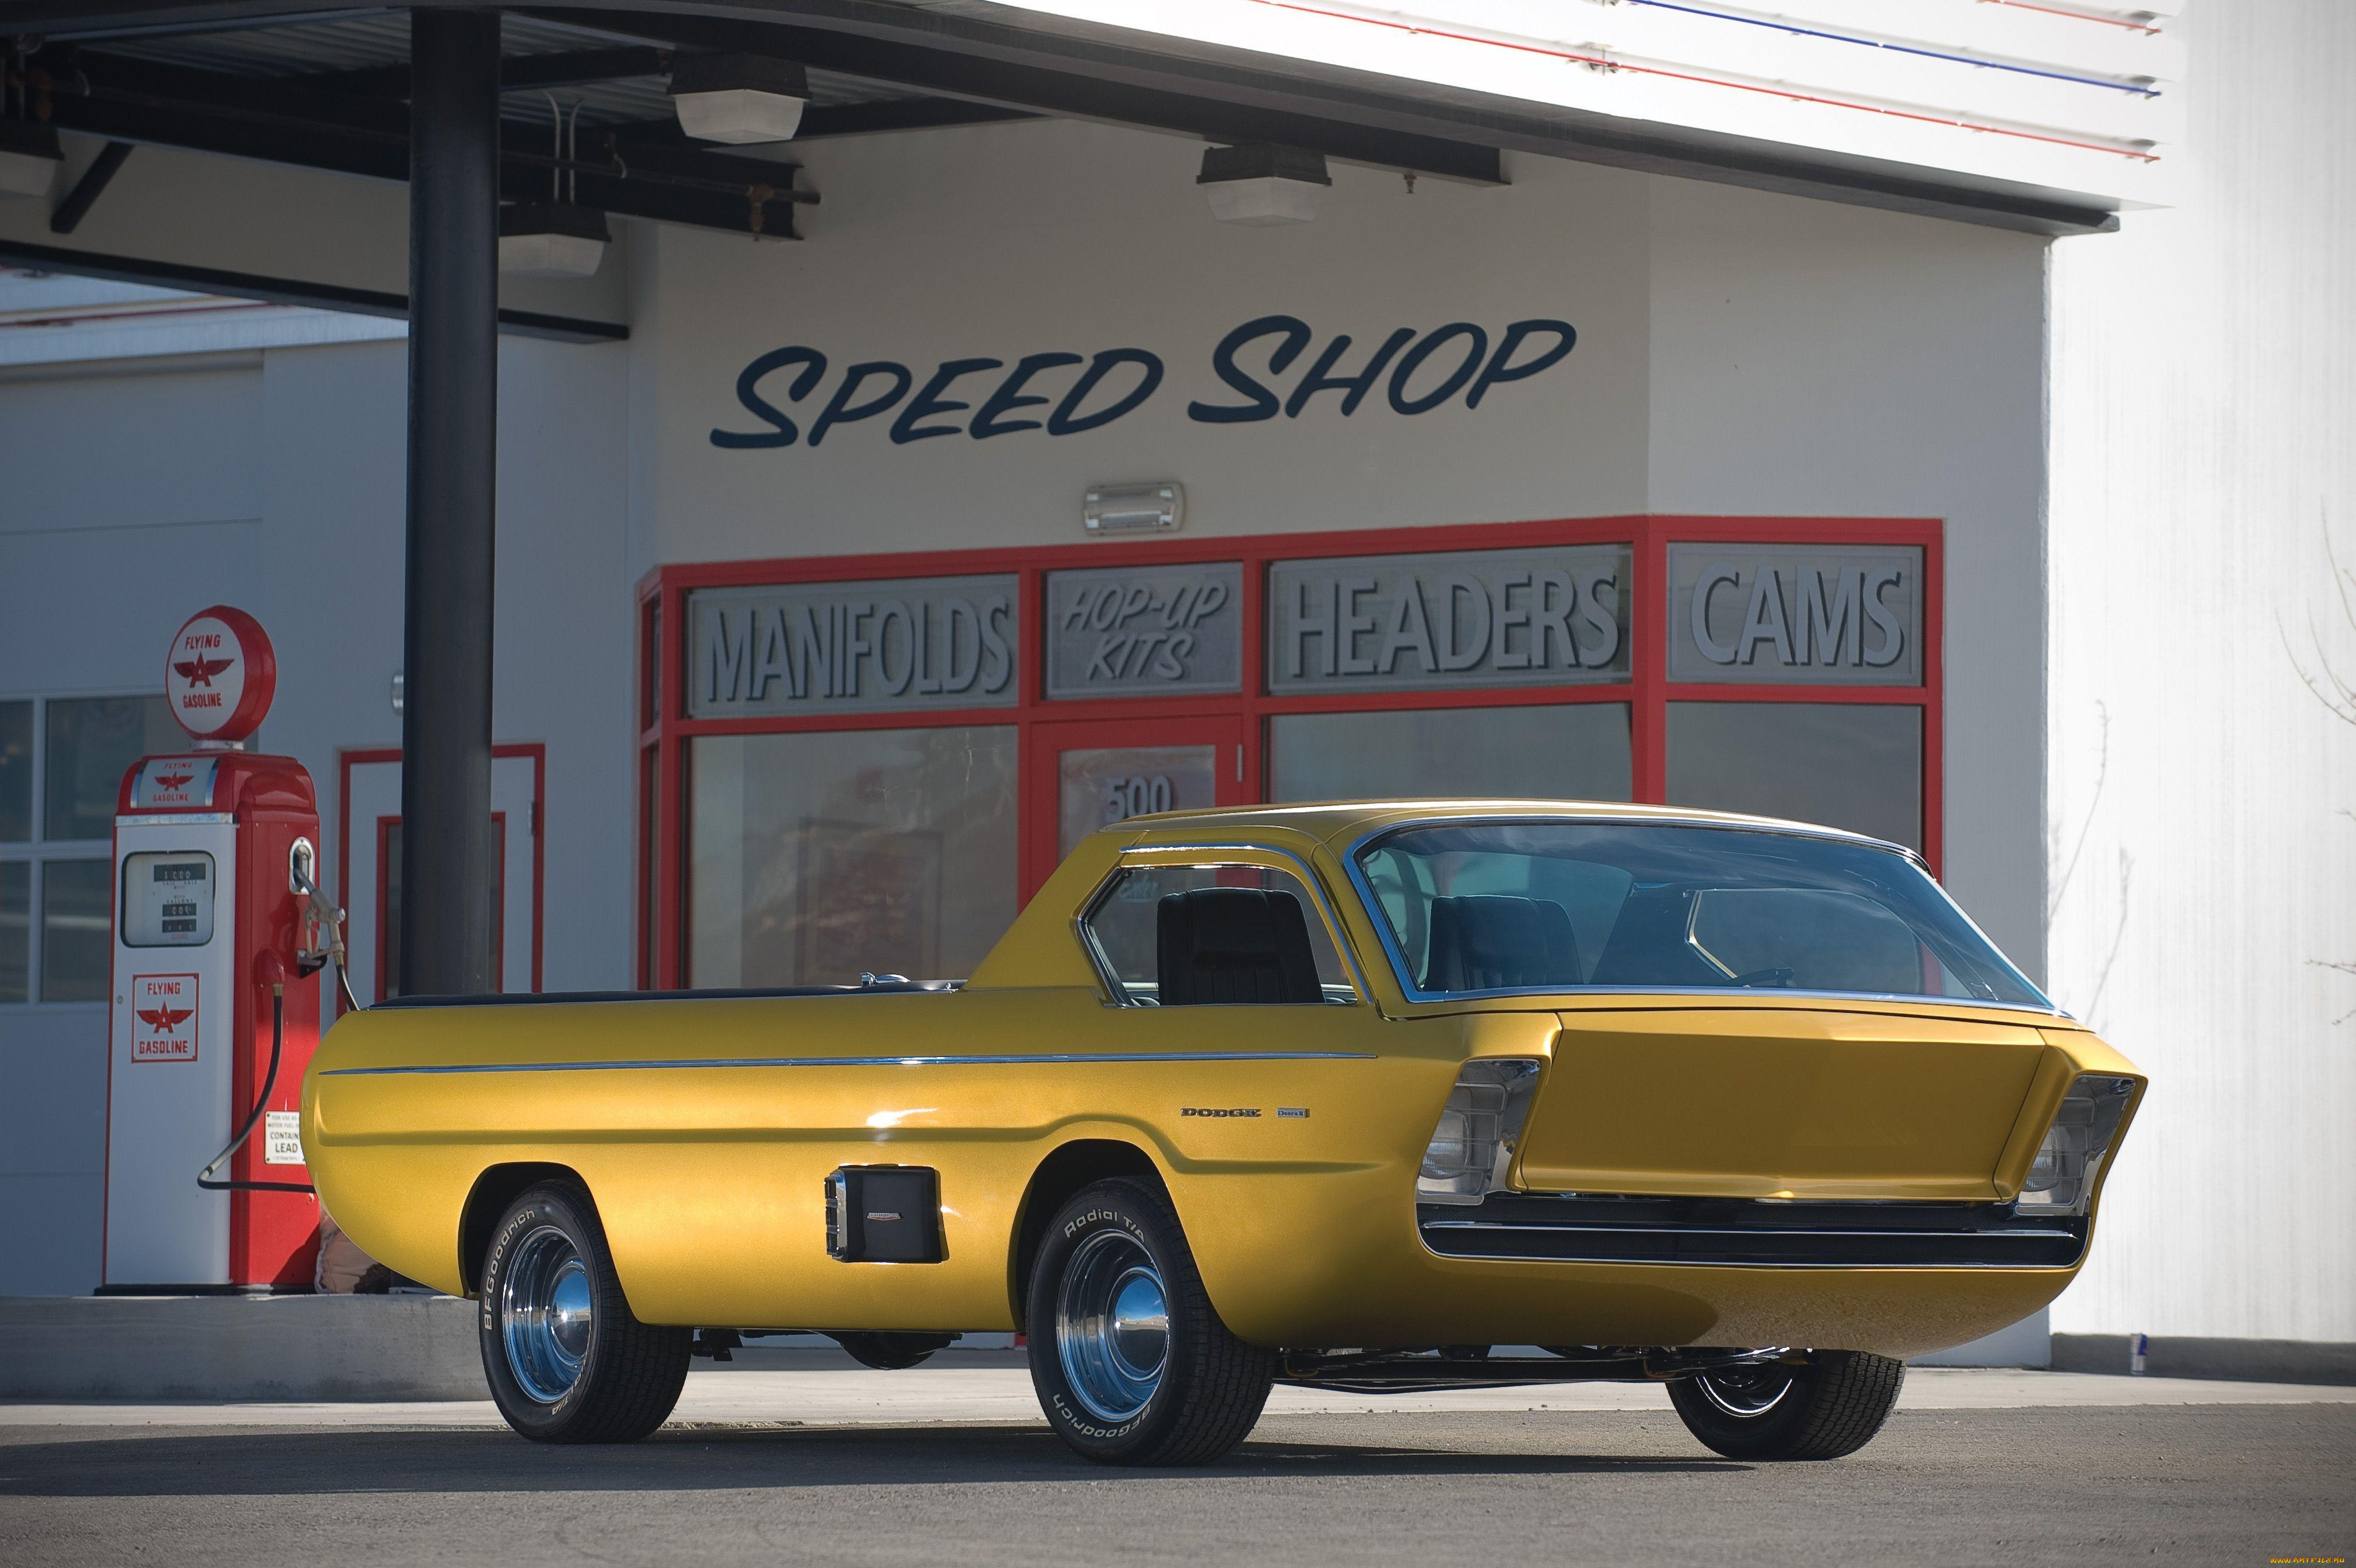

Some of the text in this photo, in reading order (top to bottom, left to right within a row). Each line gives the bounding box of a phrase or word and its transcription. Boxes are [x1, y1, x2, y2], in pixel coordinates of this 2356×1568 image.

[709, 315, 1577, 449] SPEED SHOP
[1065, 581, 1229, 631] HOP-UP
[1288, 565, 1621, 678] HEADERS
[1691, 563, 1905, 668] CAMS
[185, 634, 221, 650] FLYING
[706, 594, 1013, 703] MANIFOLDS
[1089, 631, 1195, 680] KITS
[183, 693, 222, 708] GASOLINE
[152, 794, 189, 802] GASOLINE
[1104, 774, 1173, 821] 500
[147, 982, 181, 995] FLYING
[139, 1040, 188, 1055] GASOLINE
[1181, 1108, 1261, 1118] DODGE
[271, 1131, 300, 1140] CONTAIN
[275, 1143, 298, 1153] LEAD
[1064, 1208, 1146, 1244] Radial T/A
[483, 1209, 535, 1331] BFGoodrich
[1053, 1393, 1151, 1438] BFGoodrich
